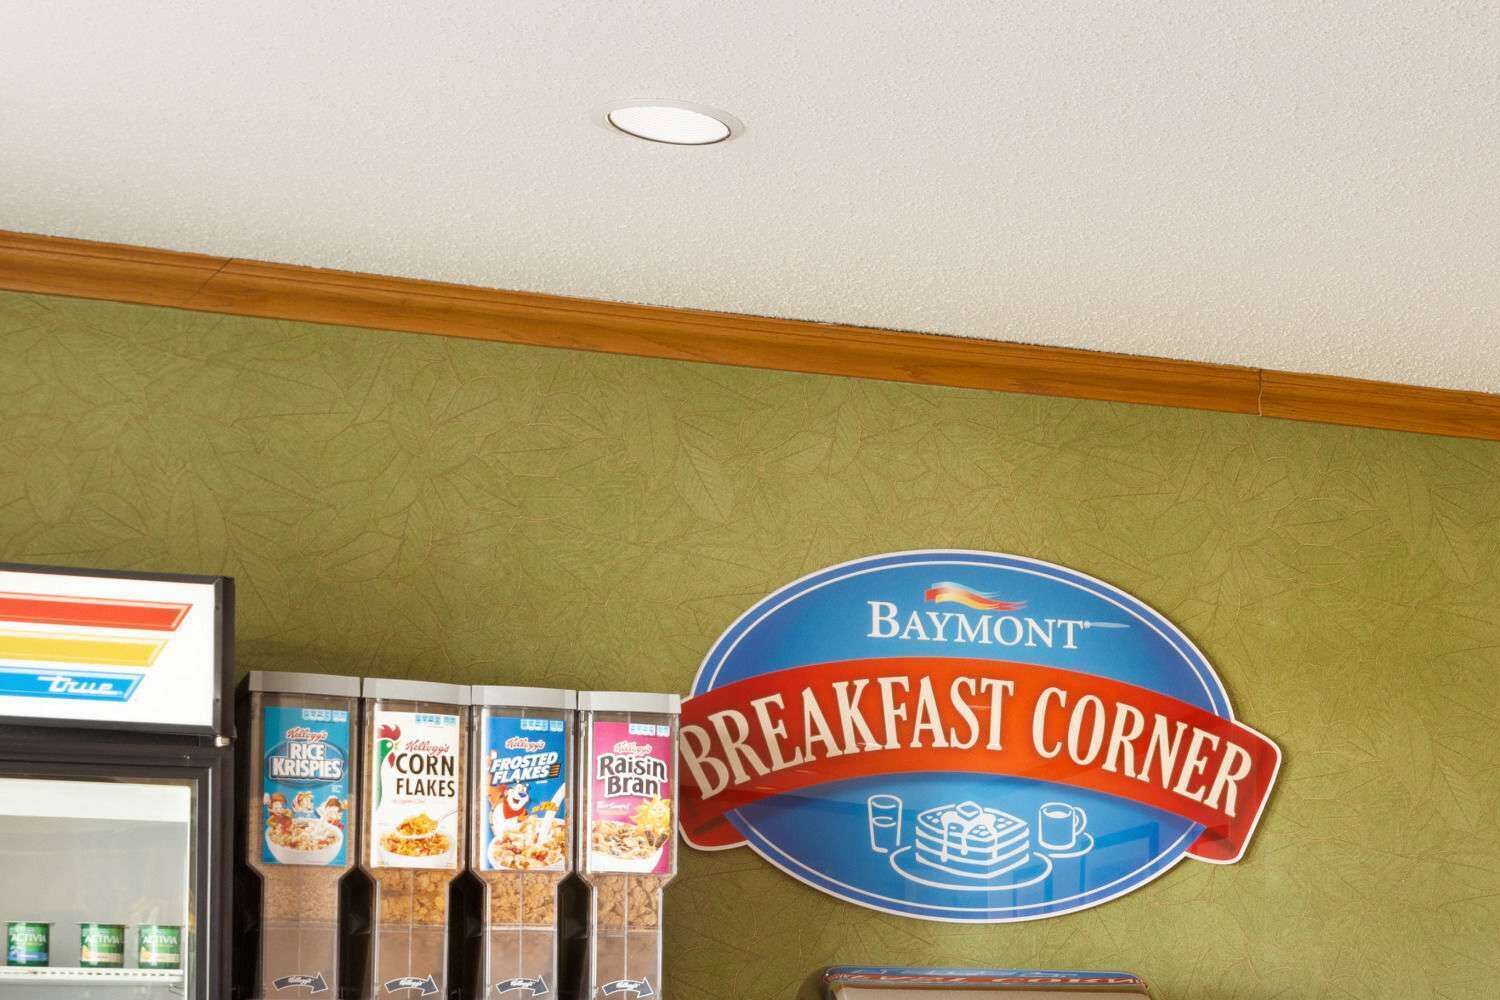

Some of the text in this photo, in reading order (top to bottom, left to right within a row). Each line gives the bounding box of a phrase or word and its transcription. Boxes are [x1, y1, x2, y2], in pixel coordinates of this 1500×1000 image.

[866, 600, 1083, 649] BAYMONT
[37, 675, 120, 696] true
[287, 726, 328, 742] Kellogg's
[289, 742, 325, 761] RICE
[404, 739, 450, 756] Kellogg's
[680, 675, 1253, 818] BREAKFAST CORNER
[271, 757, 343, 779] KRISPIES
[395, 753, 455, 777] CORN
[490, 752, 559, 773] FROSTED
[600, 755, 665, 779] Raisin
[492, 765, 550, 785] FLAKES
[607, 775, 659, 795] Bran
[396, 778, 455, 798] FLAKES
[11, 934, 47, 943] ACTIVIA
[85, 934, 121, 944] ACTIVIA
[142, 935, 178, 945] ACTIVIA
